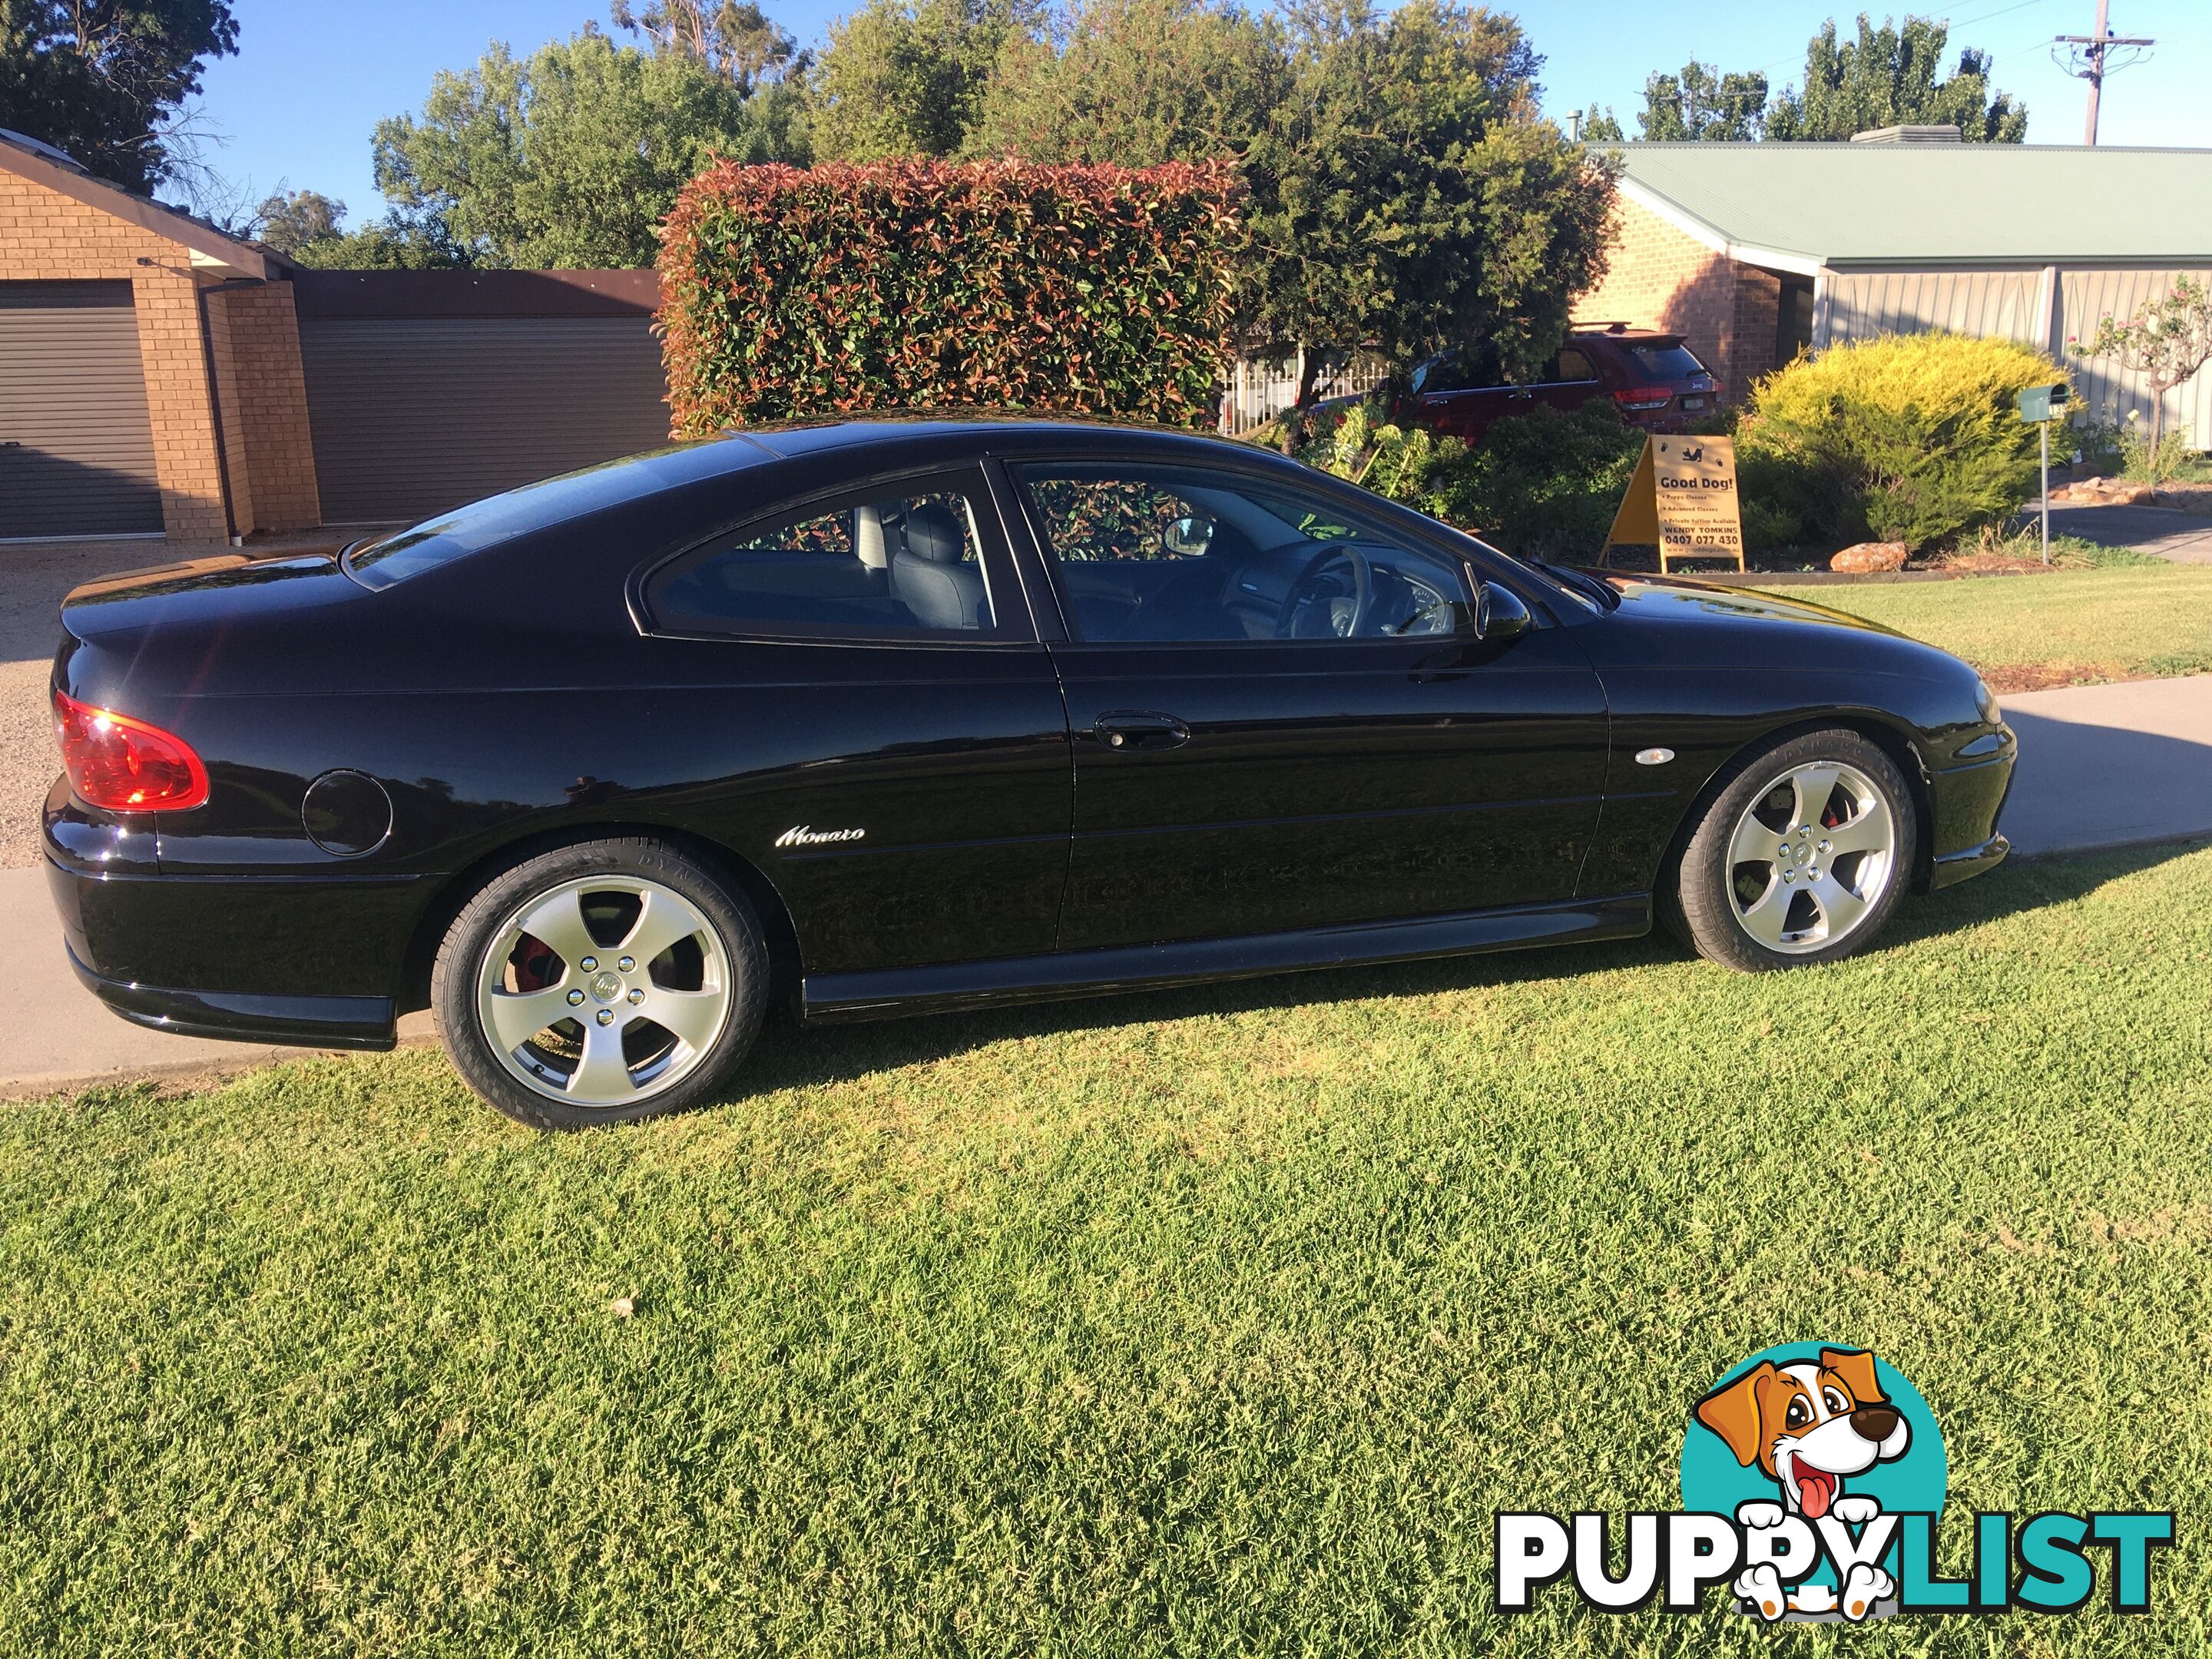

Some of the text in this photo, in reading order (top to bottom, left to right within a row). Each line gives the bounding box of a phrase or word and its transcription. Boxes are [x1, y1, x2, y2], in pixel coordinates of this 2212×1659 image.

[2051, 405, 2068, 414] 139
[1661, 477, 1733, 491] Good Dog!
[1665, 535, 1738, 545] 0407 077 430
[775, 825, 866, 847] Monaro
